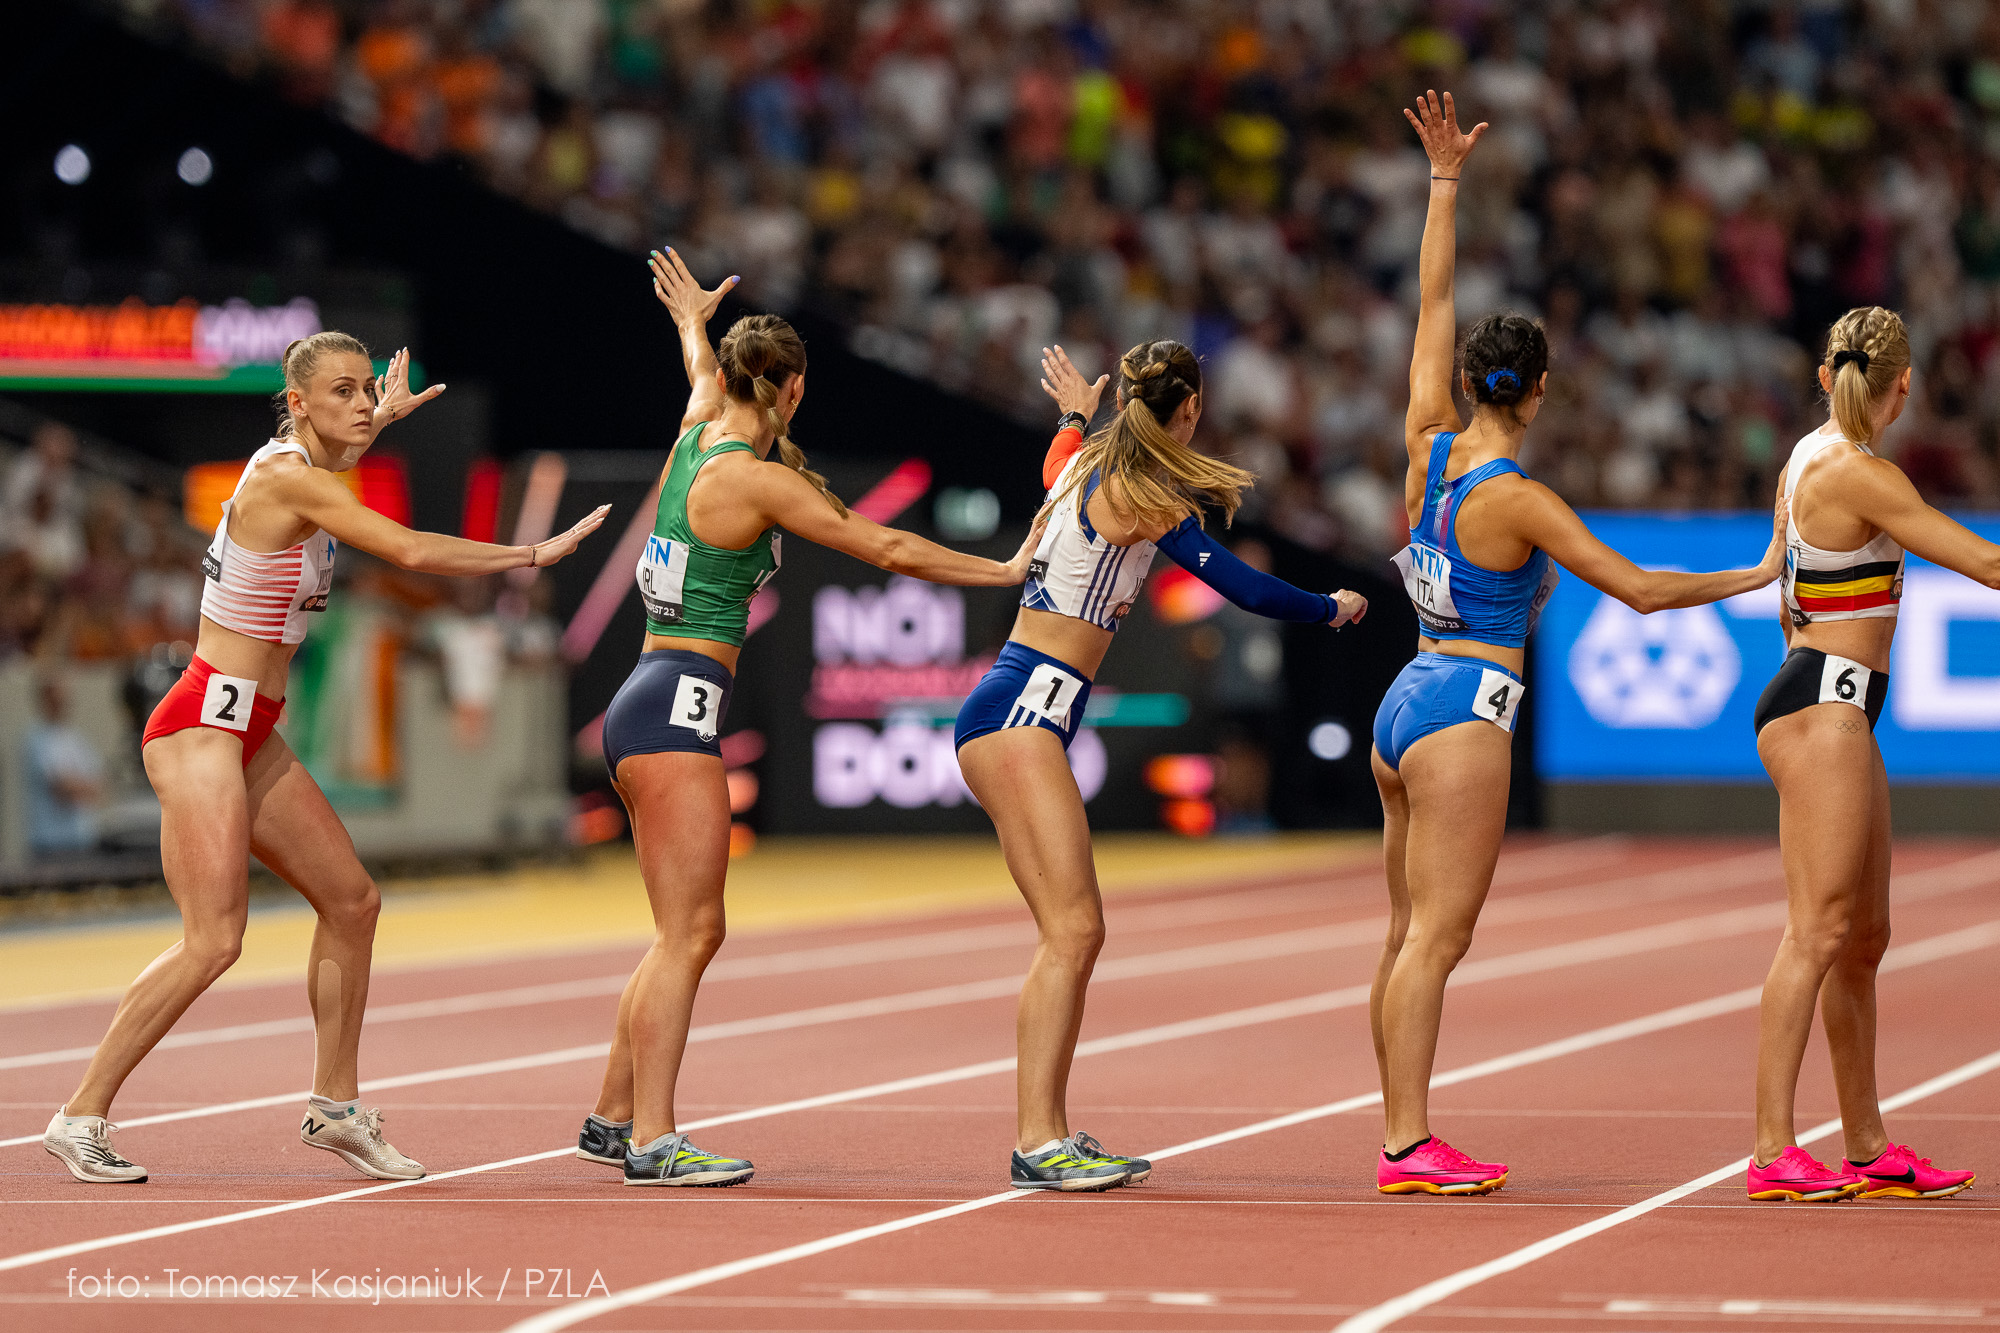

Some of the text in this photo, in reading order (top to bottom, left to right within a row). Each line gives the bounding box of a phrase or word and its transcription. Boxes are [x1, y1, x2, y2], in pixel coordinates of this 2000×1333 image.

[646, 536, 671, 567] TN
[1030, 563, 1043, 573] 23
[1408, 546, 1445, 583] NTN
[642, 566, 656, 595] IRL
[1417, 577, 1436, 610] ITA
[663, 606, 676, 617] 23
[1447, 620, 1460, 629] 23
[1043, 676, 1063, 711] 1
[1835, 667, 1856, 700] 6
[215, 684, 239, 722] 2
[687, 686, 708, 721] 3
[1488, 684, 1510, 718] 4
